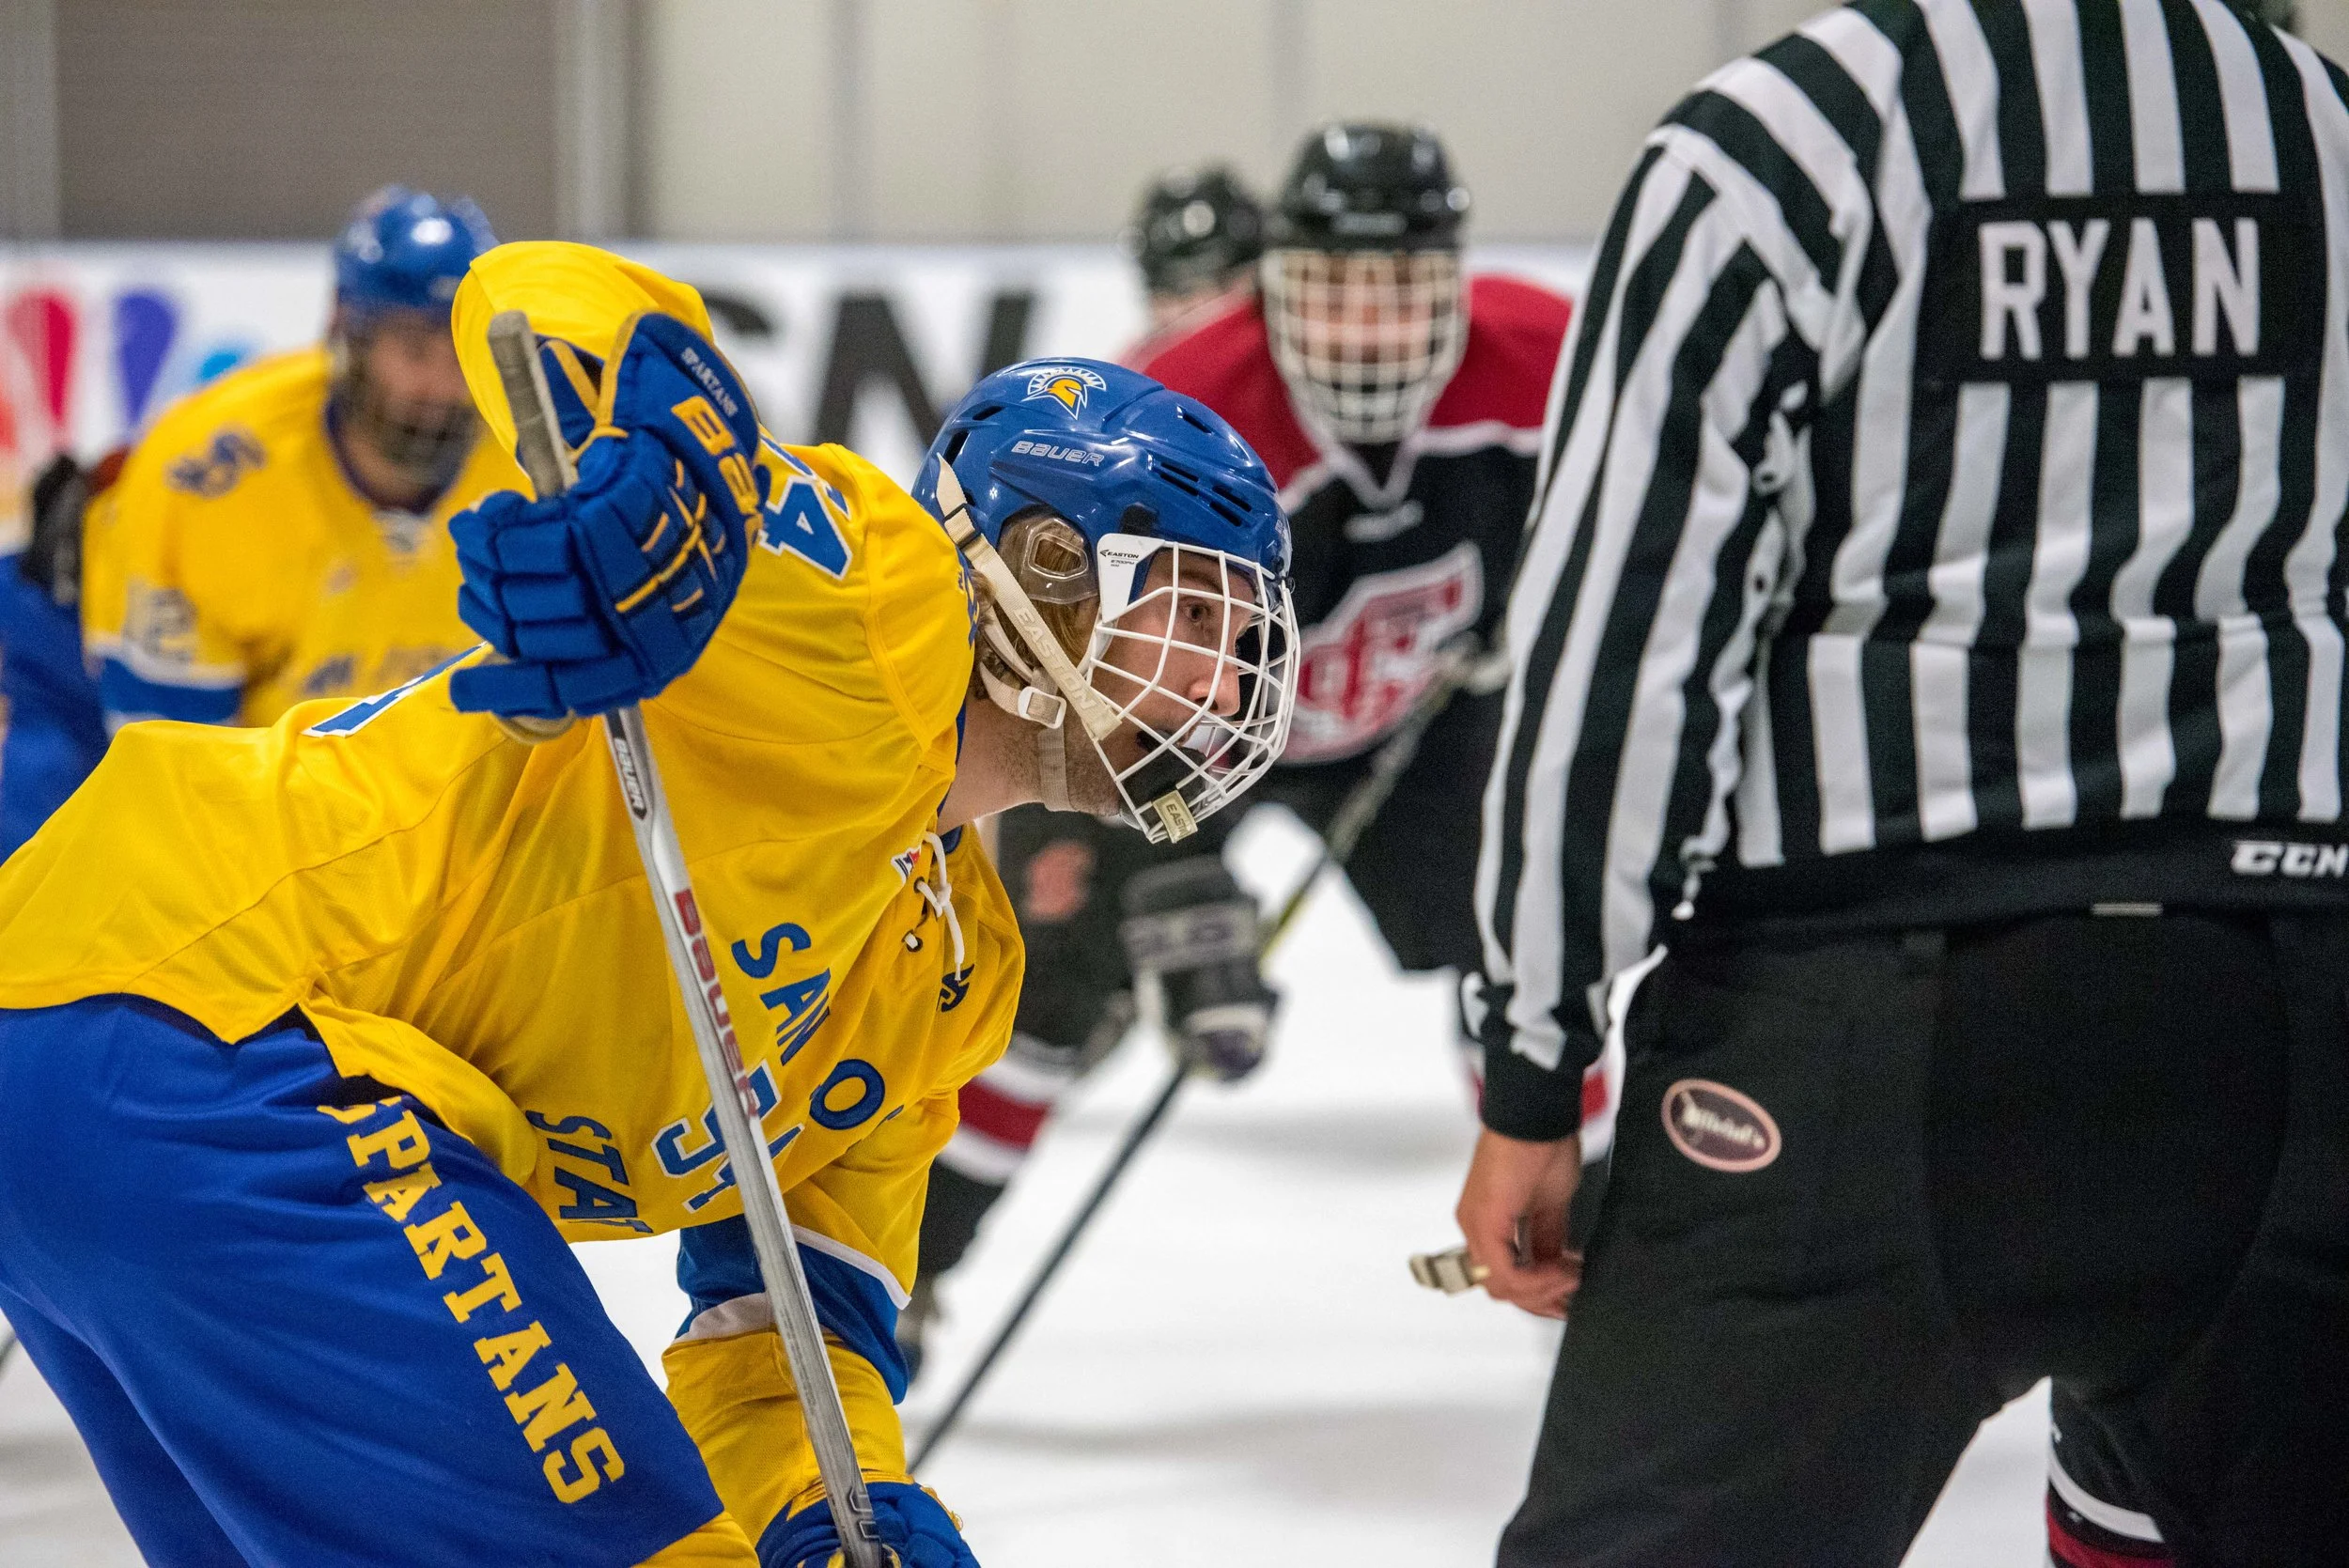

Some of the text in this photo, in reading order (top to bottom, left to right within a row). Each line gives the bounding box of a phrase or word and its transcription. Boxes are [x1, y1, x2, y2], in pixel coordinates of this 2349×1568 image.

[1979, 218, 2261, 360] RYAN
[680, 347, 739, 418] SPARTANS
[1107, 551, 1140, 559] EASTON
[1013, 607, 1098, 711] EASTON
